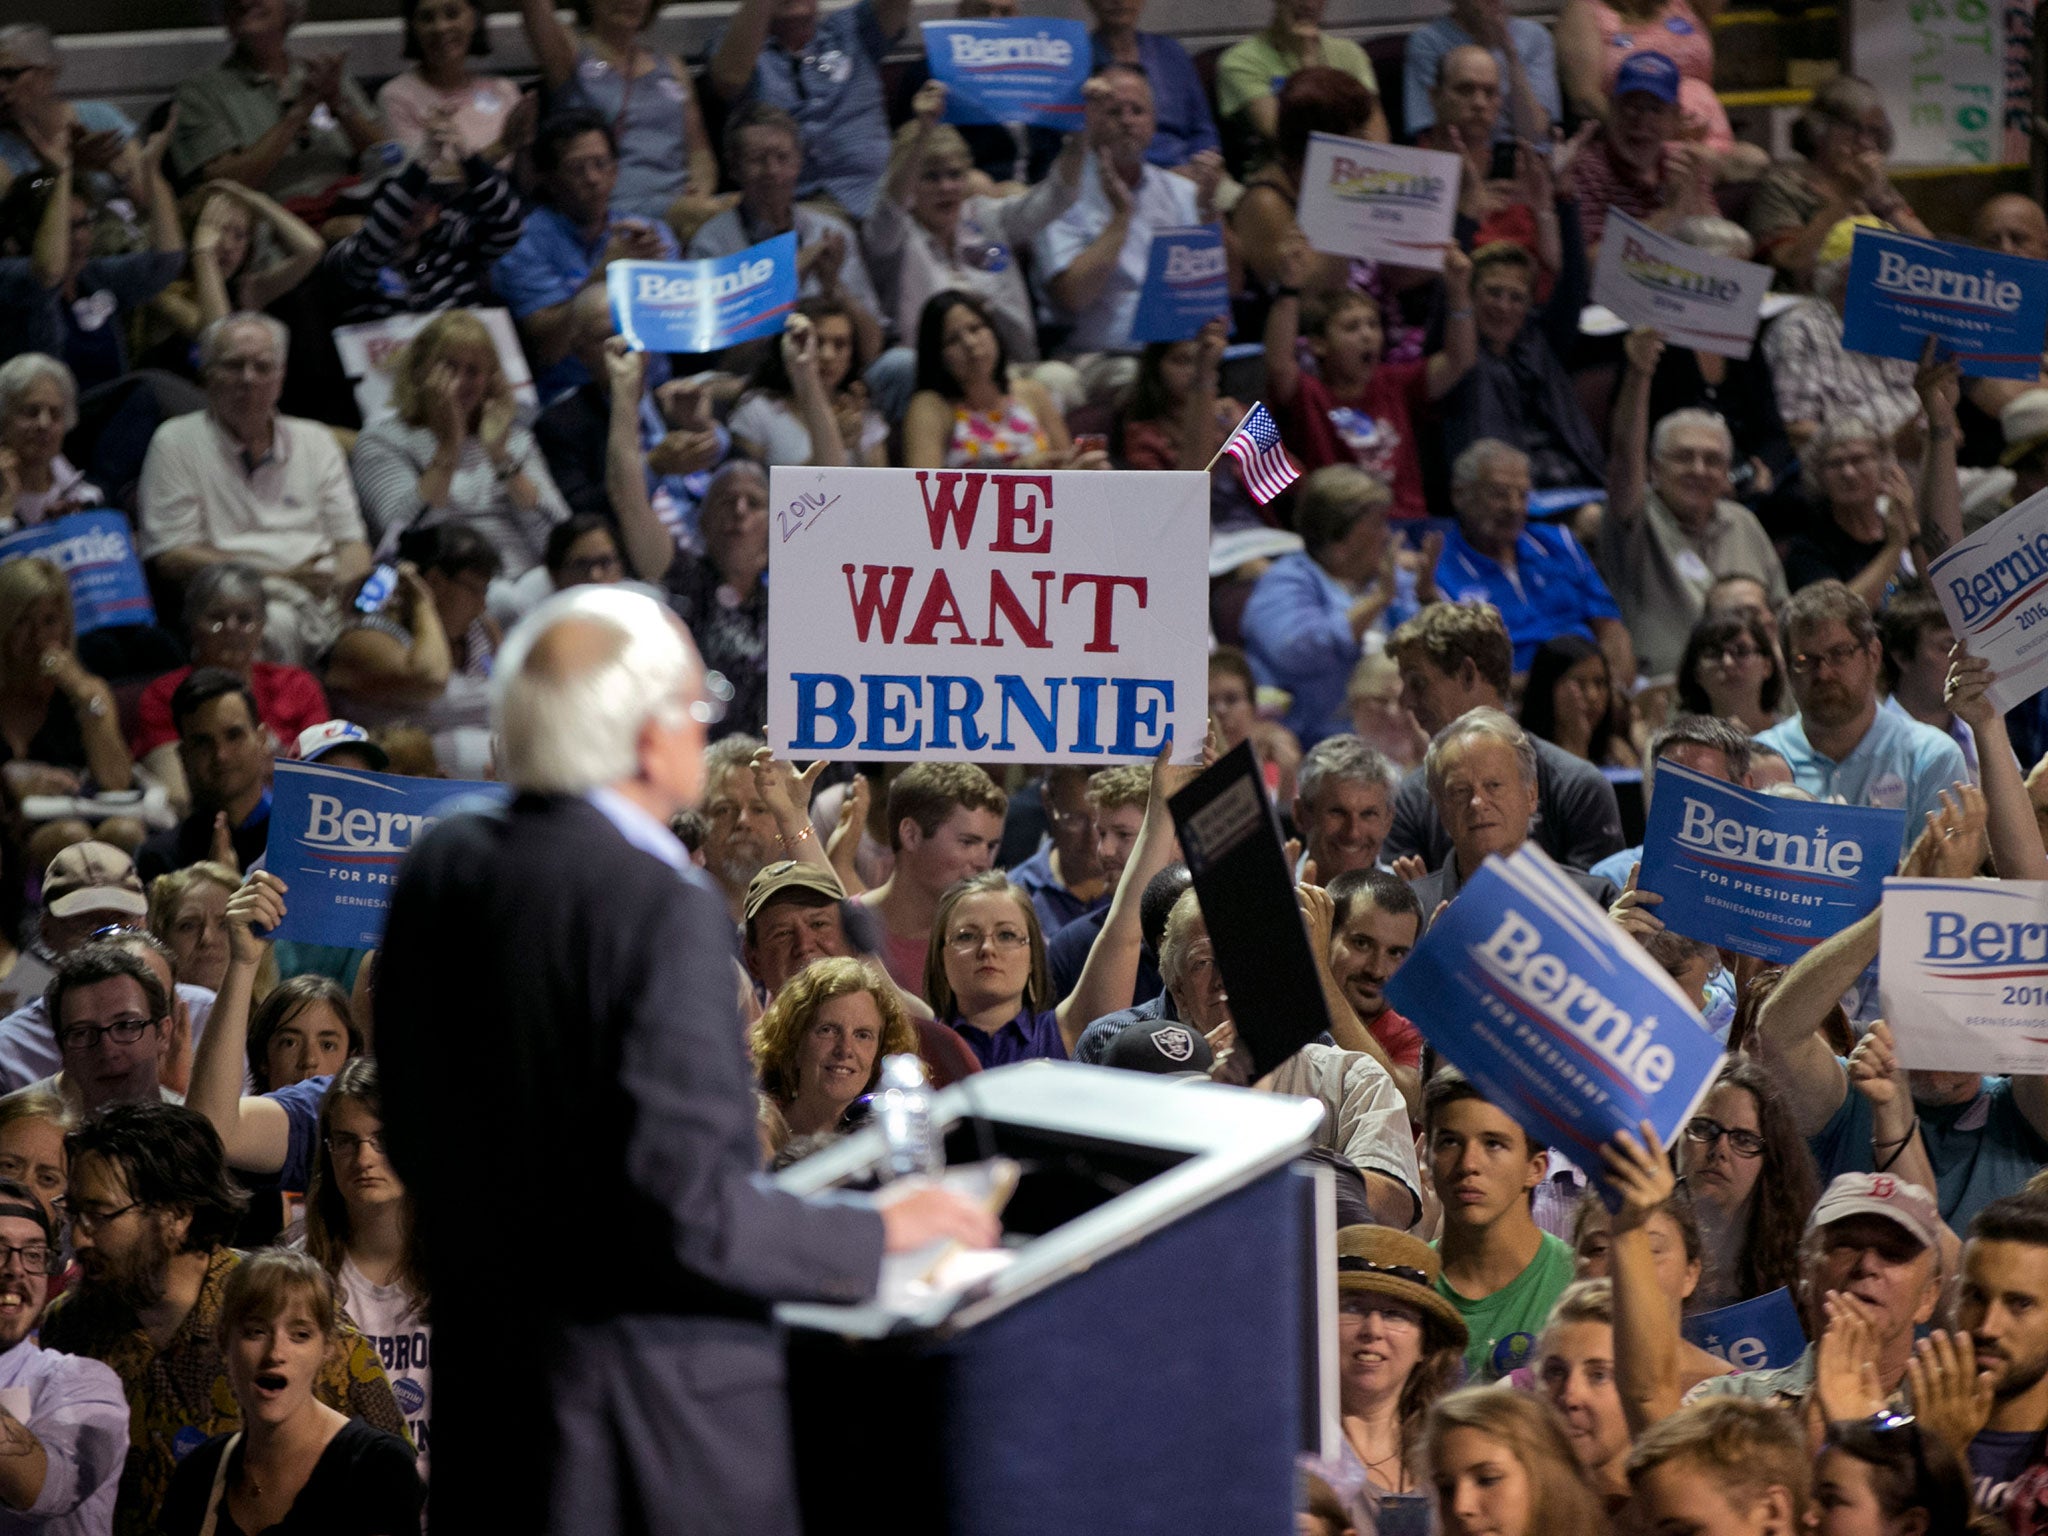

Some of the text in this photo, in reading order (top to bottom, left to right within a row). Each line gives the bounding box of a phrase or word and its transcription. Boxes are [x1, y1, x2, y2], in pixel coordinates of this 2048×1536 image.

[948, 31, 1073, 66] Bernie
[637, 258, 775, 300] Bernie
[1876, 249, 2023, 313] Bernie
[777, 491, 827, 544] 2016
[914, 471, 1054, 554] WE
[841, 563, 1148, 653] WANT
[788, 672, 1175, 757] BERNIE
[1678, 796, 1864, 877] Bernie
[329, 868, 361, 882] FOR
[1700, 869, 1824, 908] FOR PRESIDENT
[1704, 895, 1813, 928] BERNIESANDERS.COM
[1924, 911, 2048, 964] Ber
[1476, 908, 1676, 1094] Bernie
[1481, 993, 1517, 1027] FOR
[1515, 1023, 1610, 1104] PRESIDENT
